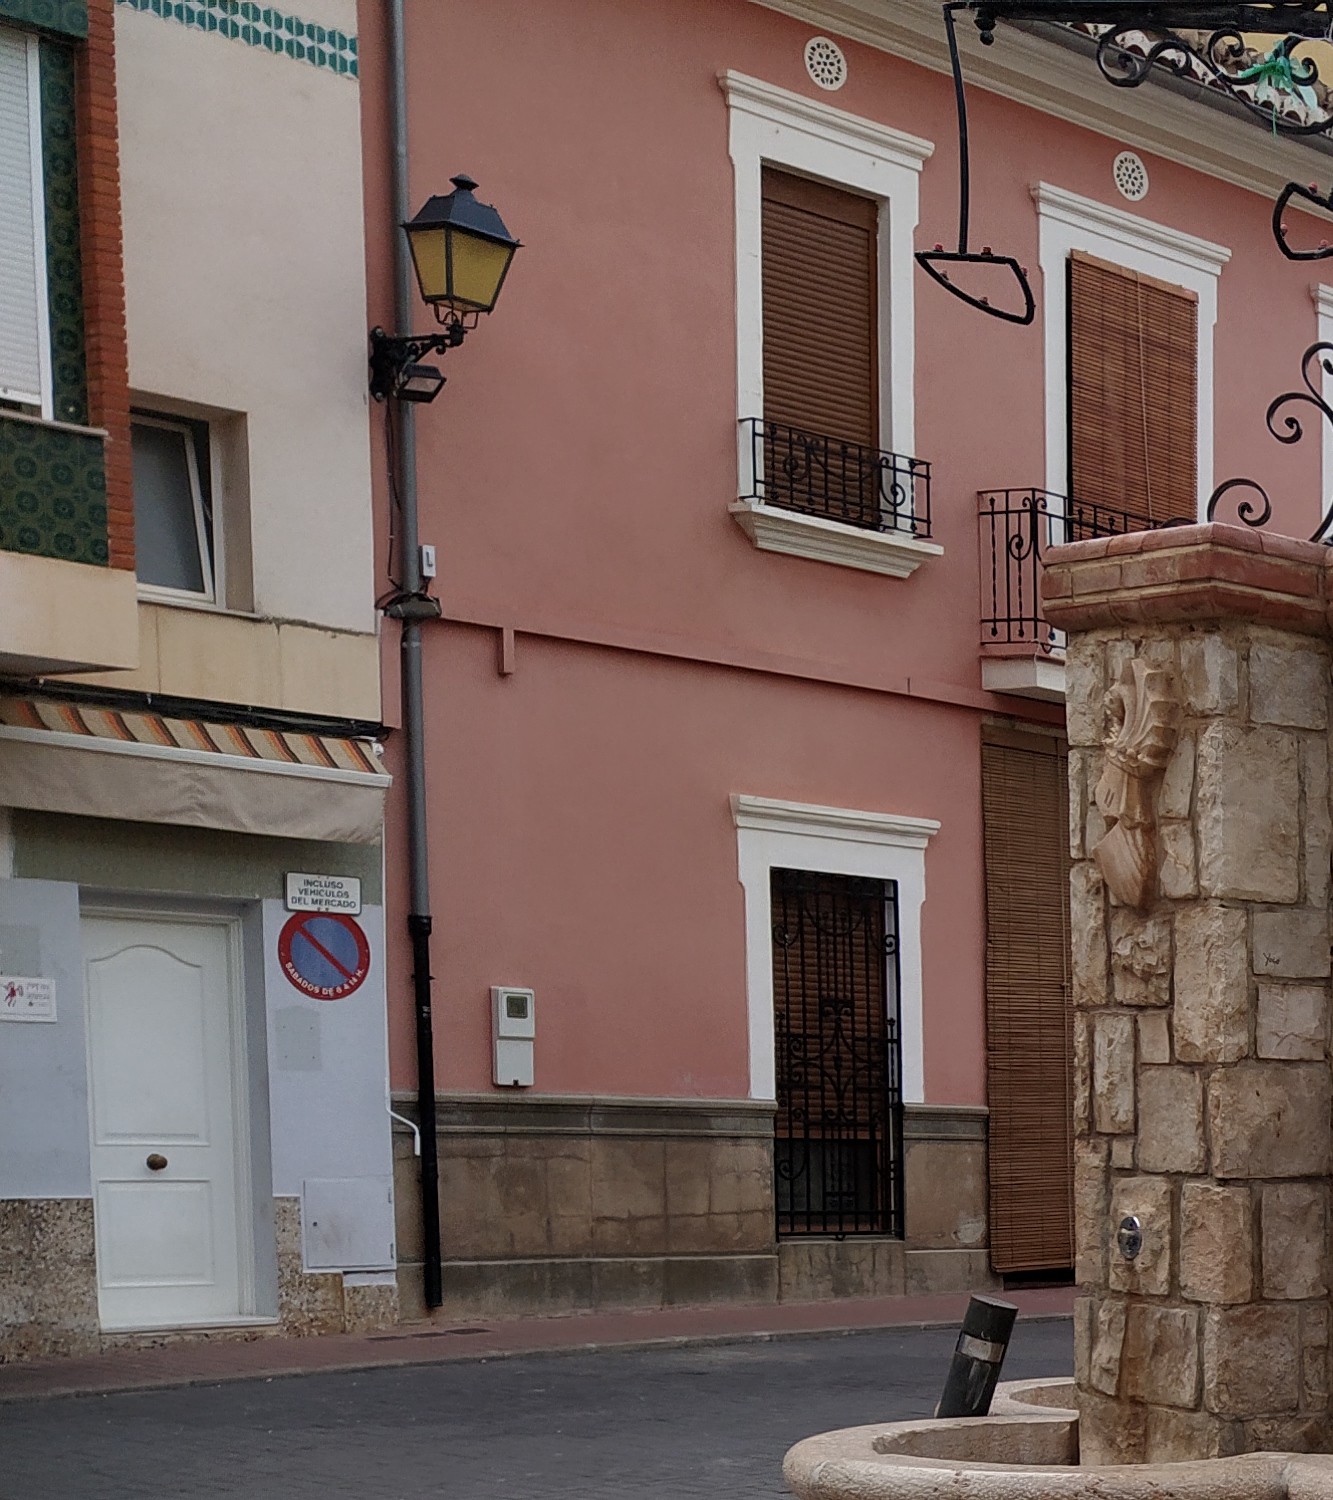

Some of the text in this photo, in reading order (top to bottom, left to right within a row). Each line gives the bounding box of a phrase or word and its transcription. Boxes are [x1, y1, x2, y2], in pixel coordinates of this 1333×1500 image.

[303, 879, 344, 889] INCLUSO
[298, 888, 349, 898] VEHICULOS
[291, 896, 356, 908] DEL MERCADO
[285, 961, 320, 994] SABADOS
[322, 987, 334, 996] DE
